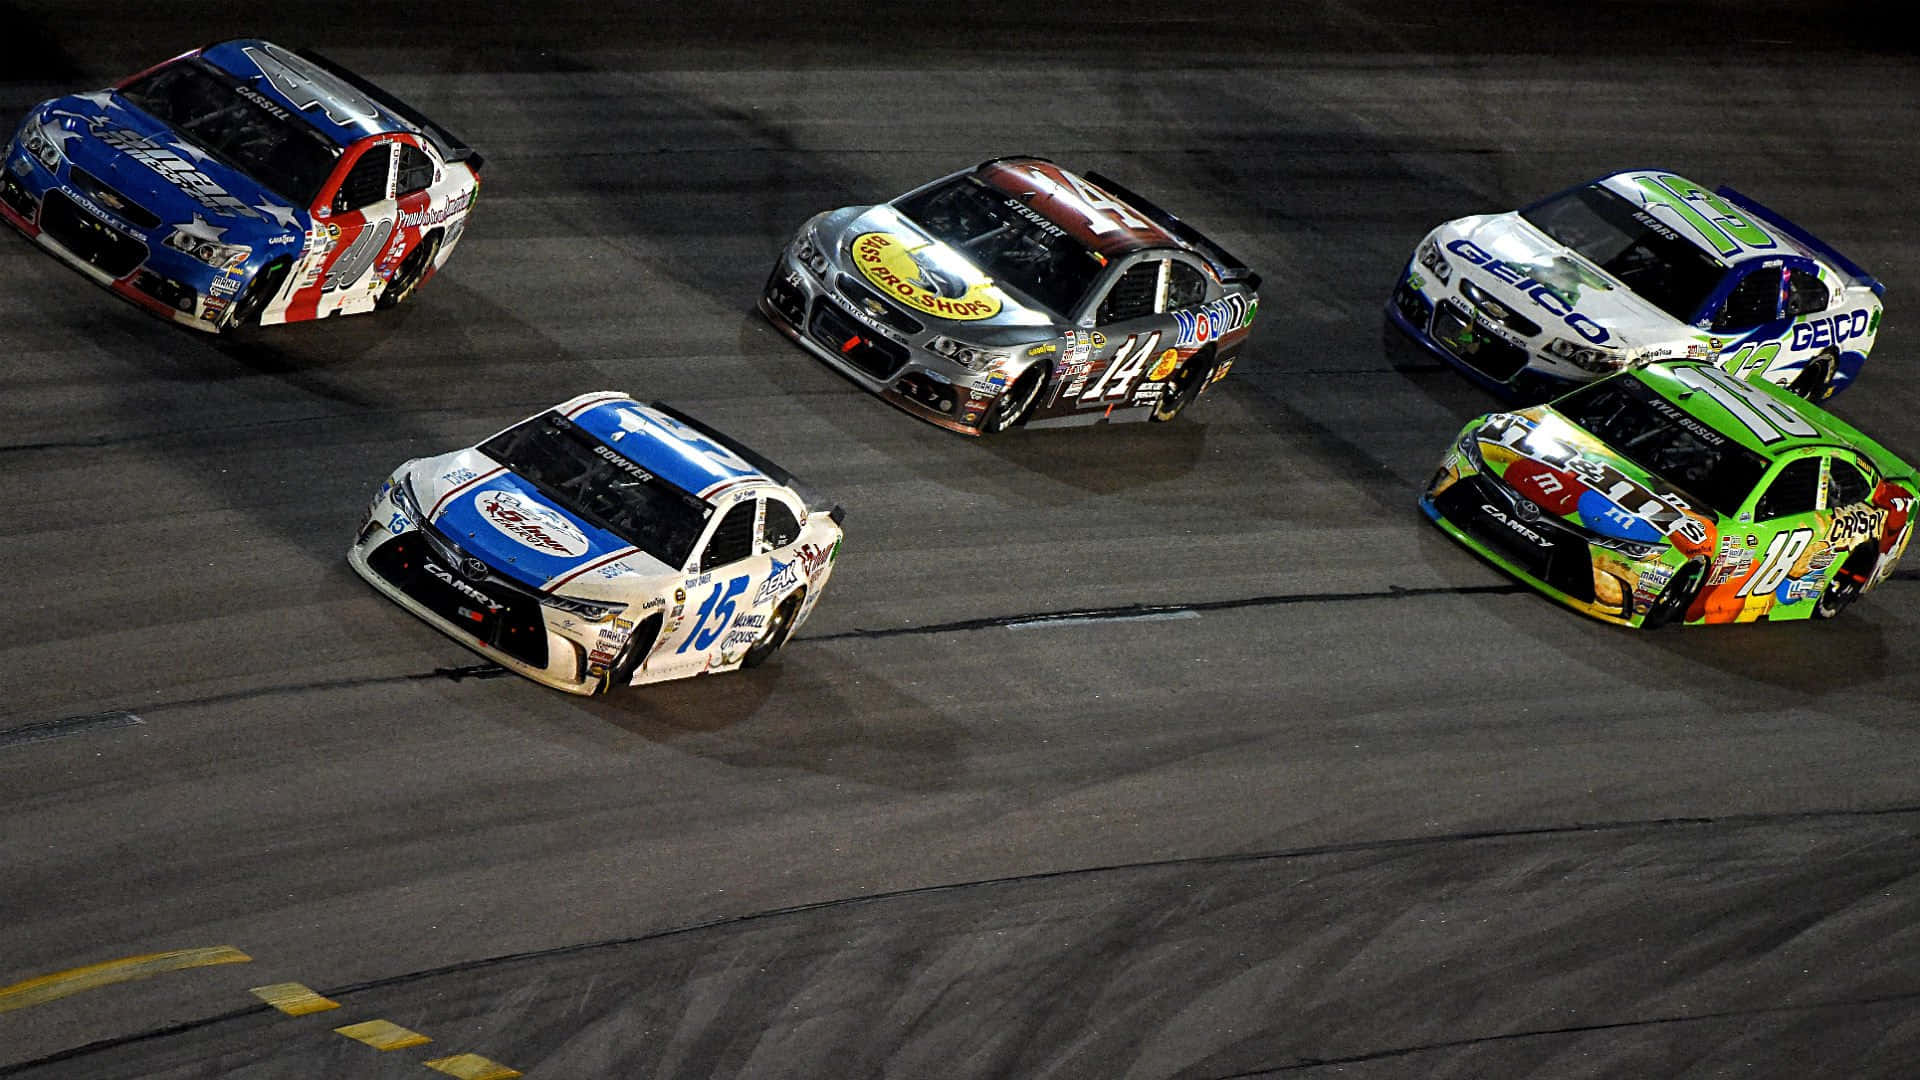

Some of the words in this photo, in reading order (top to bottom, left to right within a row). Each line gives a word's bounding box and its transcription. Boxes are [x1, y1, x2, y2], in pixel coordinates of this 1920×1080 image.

[234, 85, 292, 121] CASSILL
[113, 129, 262, 218] snap
[61, 184, 128, 231] CHEVROLET
[1003, 198, 1068, 239] STEWART
[1030, 166, 1149, 236] 14
[1632, 174, 1778, 259] 13
[860, 234, 892, 264] BASS
[1631, 211, 1679, 242] MEARS
[869, 265, 915, 297] PRO
[1446, 239, 1611, 345] GEICO
[921, 293, 993, 317] SHOPS
[1172, 297, 1231, 347] Mobil
[1224, 292, 1248, 333] 1
[1789, 308, 1869, 352] GEICO
[971, 379, 1000, 395] MAHLE
[1078, 329, 1162, 404] 14
[1648, 399, 1683, 420] KYLE
[1679, 417, 1726, 446] BUSCH
[1673, 364, 1822, 447] 18
[593, 445, 654, 483] BOWYER
[387, 512, 411, 536] 15
[492, 517, 552, 549] ENERGY
[1480, 503, 1556, 548] CAMRY
[1829, 509, 1886, 543] CRISPY
[423, 561, 504, 610] CAMRY
[753, 559, 798, 606] PEAK
[1735, 527, 1815, 599] 18
[598, 628, 628, 644] MAHLE
[675, 574, 750, 655] 15
